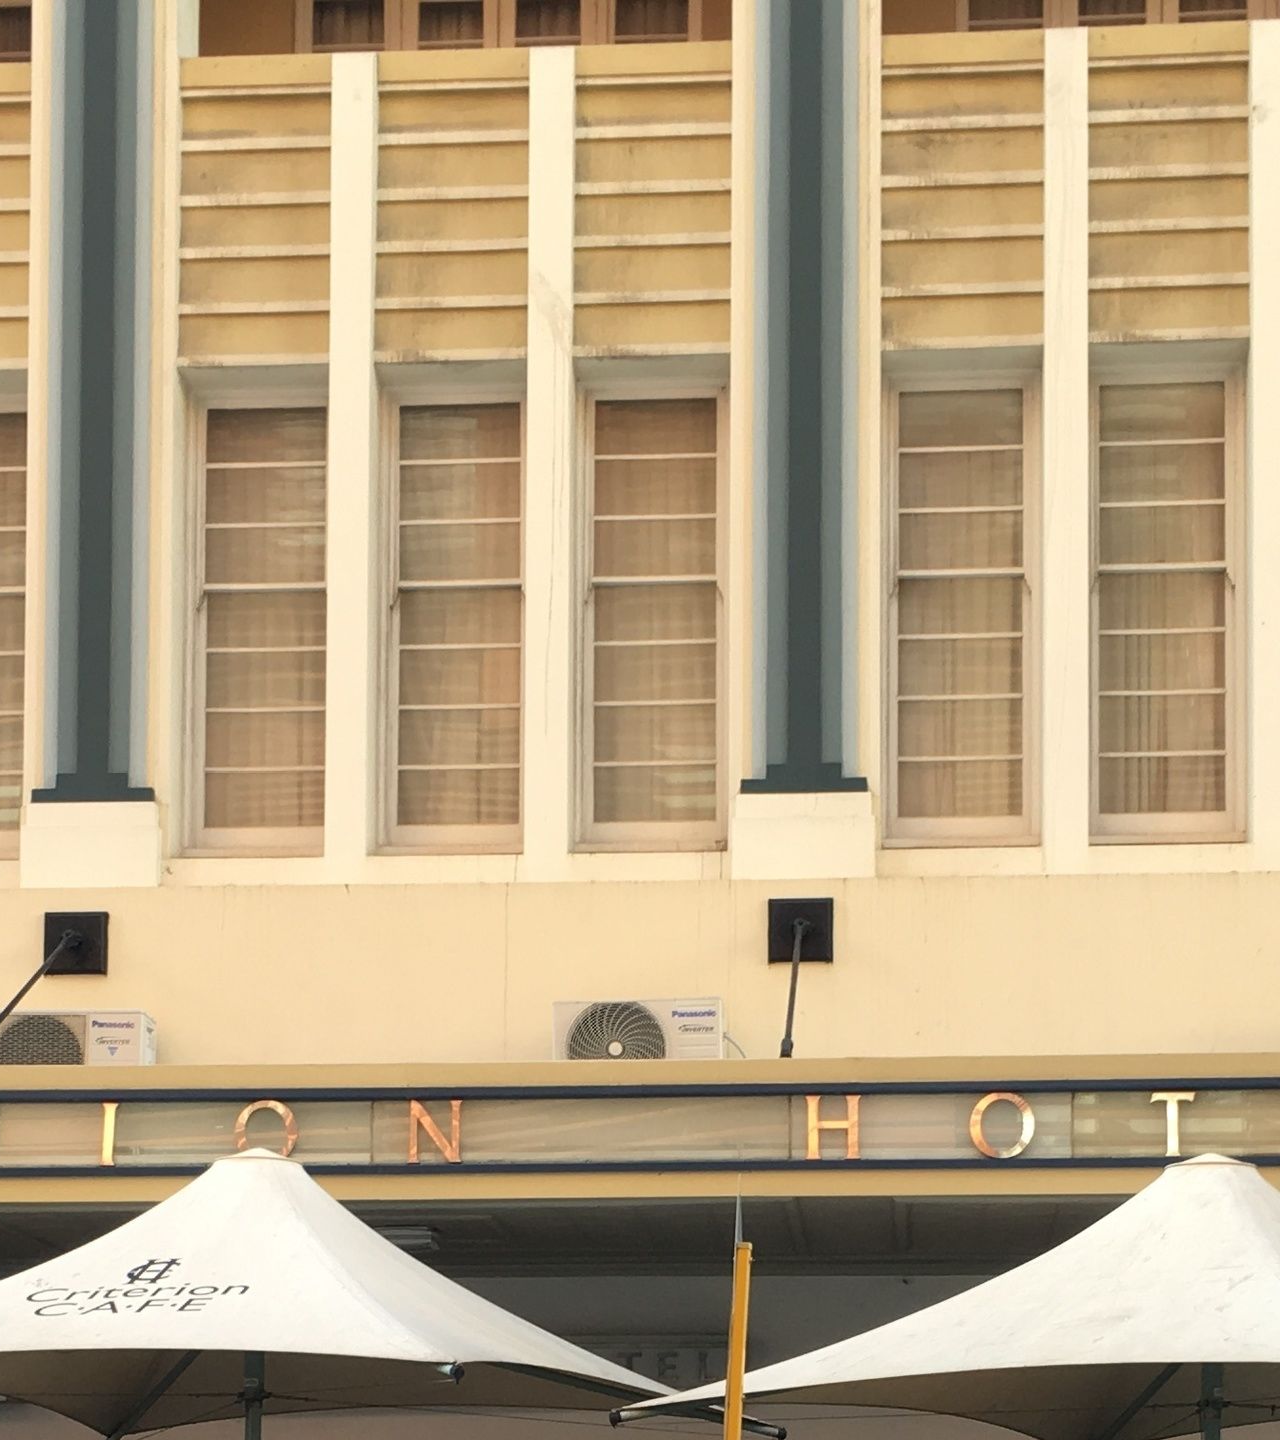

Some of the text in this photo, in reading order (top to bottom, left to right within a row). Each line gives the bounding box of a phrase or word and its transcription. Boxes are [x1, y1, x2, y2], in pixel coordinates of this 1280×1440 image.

[672, 1010, 717, 1018] Panasonic
[92, 1020, 135, 1028] Panasonic
[26, 1282, 250, 1302] Criterion
